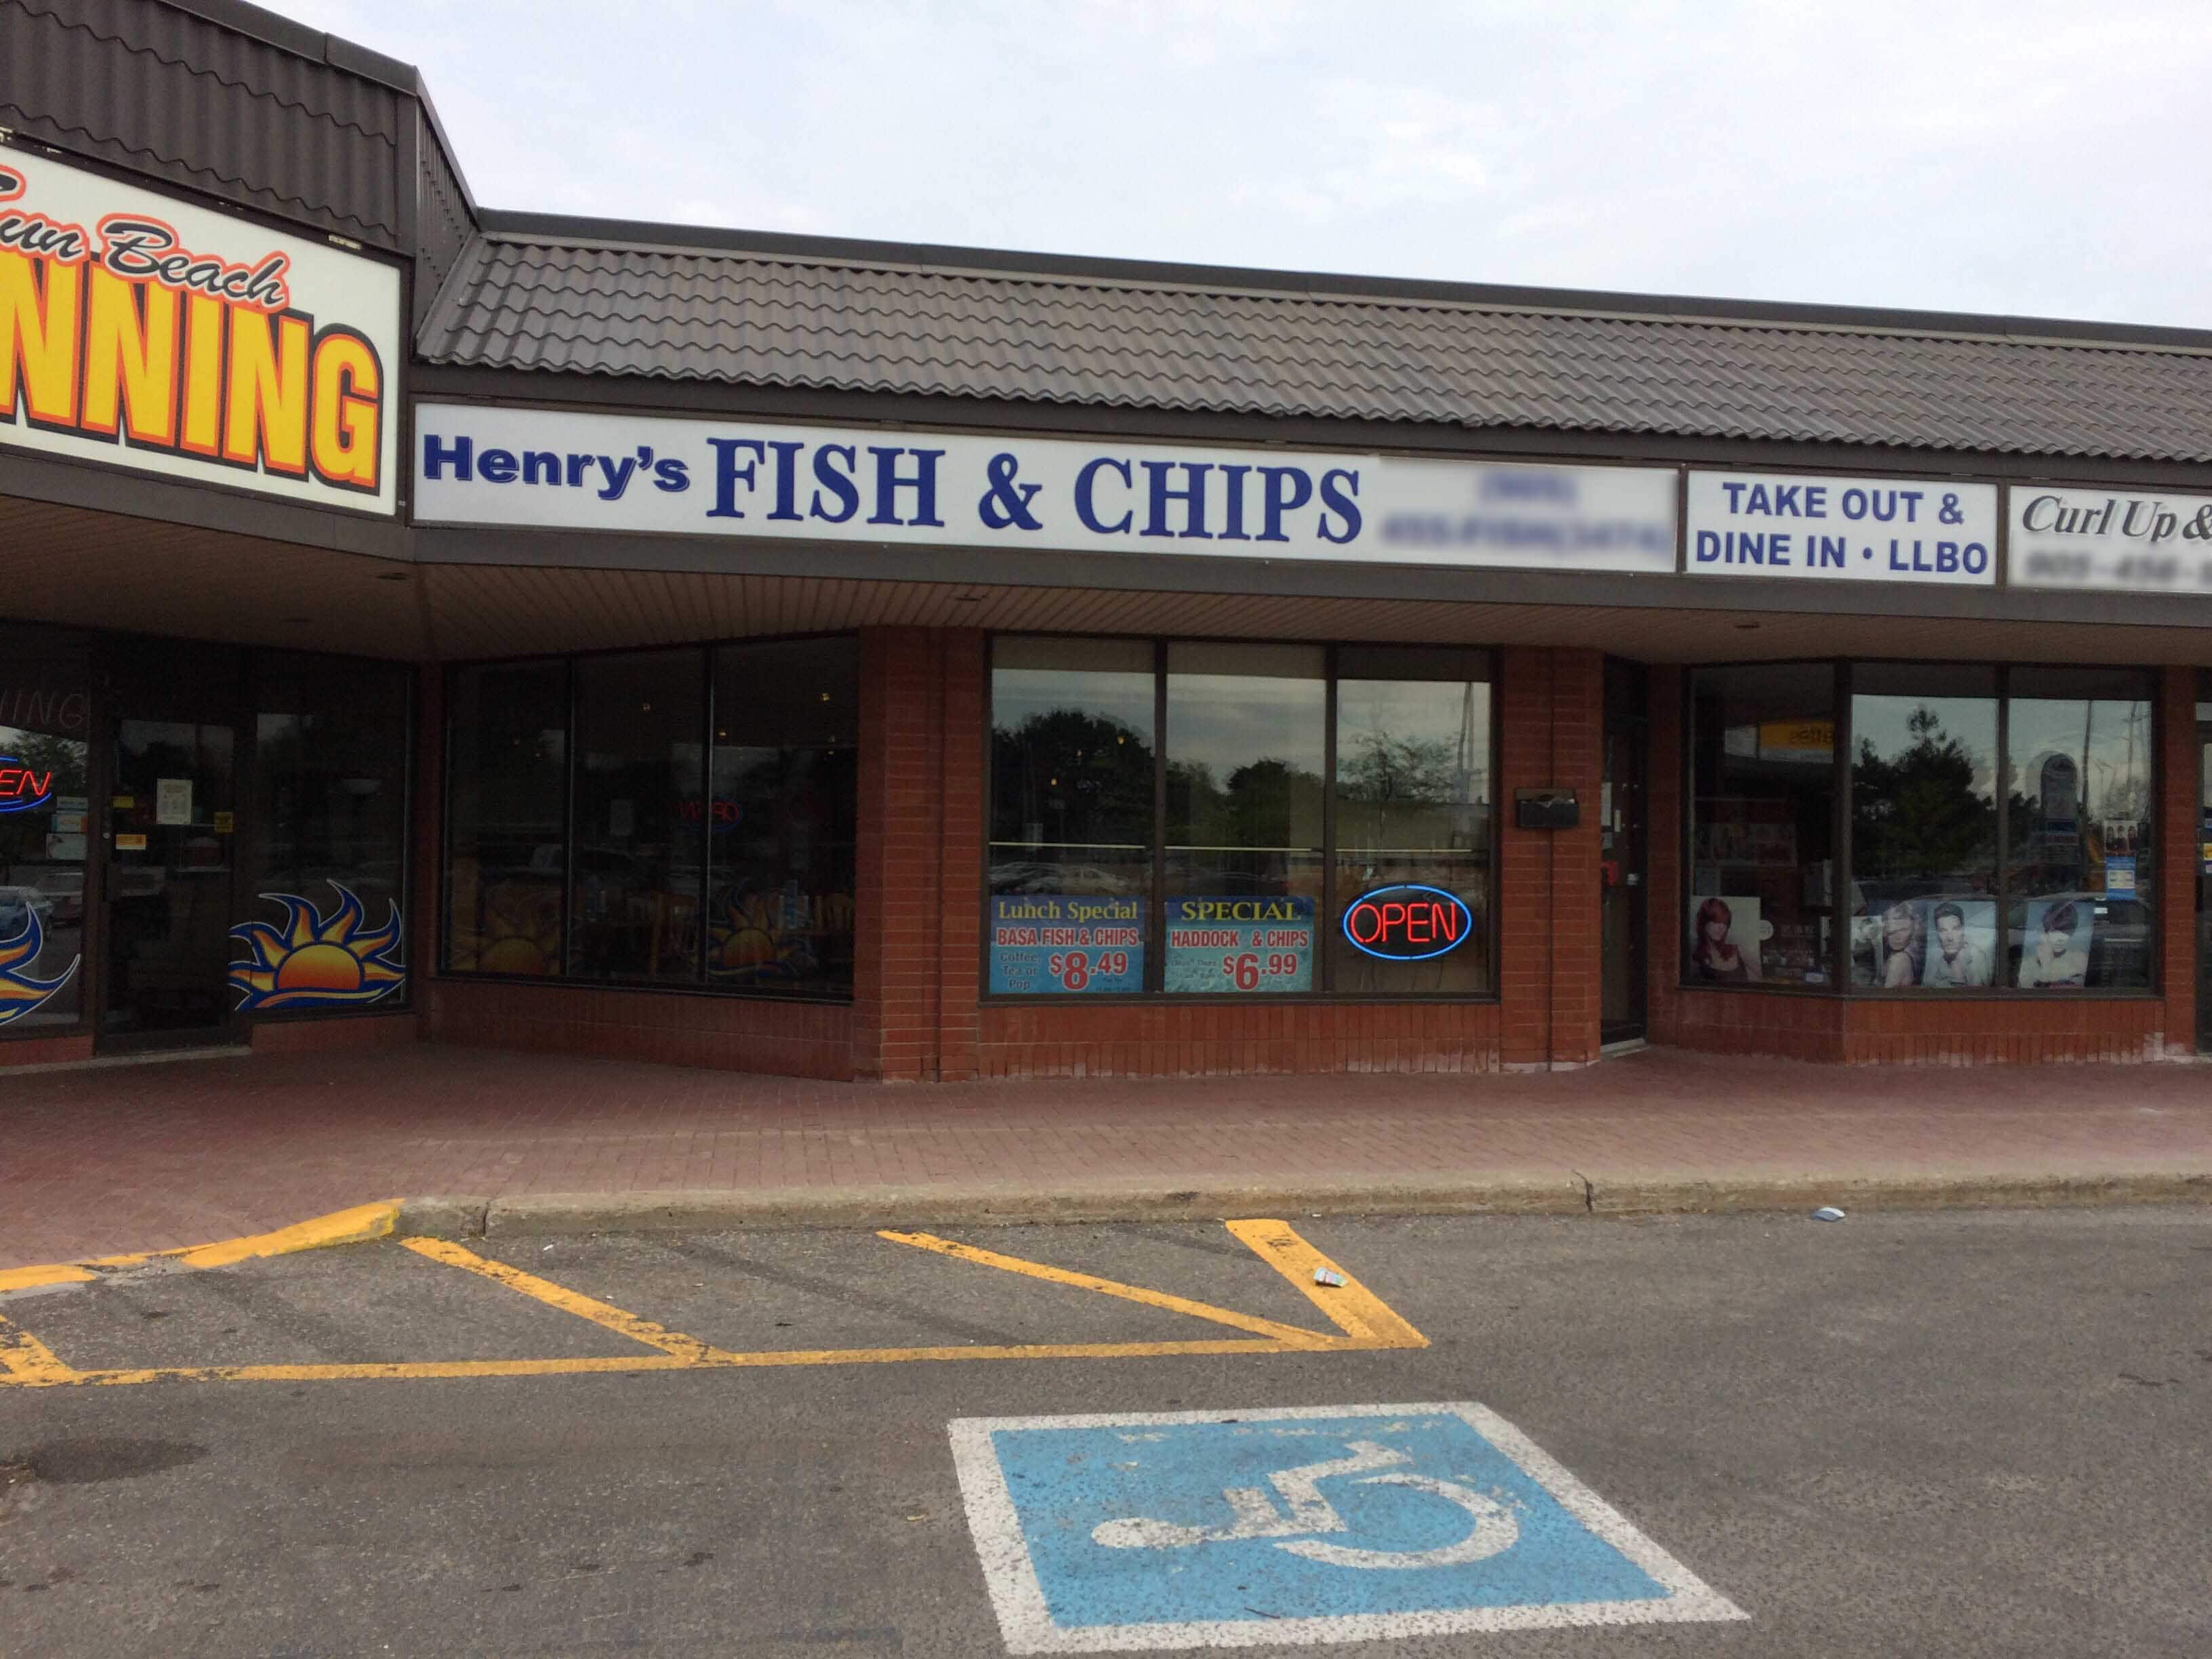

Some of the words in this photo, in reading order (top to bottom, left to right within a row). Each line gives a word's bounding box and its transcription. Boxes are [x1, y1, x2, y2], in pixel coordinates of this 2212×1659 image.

[102, 218, 286, 308] Beach
[423, 434, 689, 500] Henry's
[705, 437, 945, 527] FISH
[977, 452, 1042, 531] &
[1073, 456, 1363, 544] CHIPS
[1722, 481, 1827, 519] TAKE
[1841, 487, 1925, 523] OUT
[1938, 493, 1964, 525] &
[2022, 495, 2116, 535] Curl
[2122, 500, 2177, 542] Up
[2182, 504, 2212, 540] &
[1695, 530, 1791, 566] DINE
[1805, 535, 1847, 569] IN
[1887, 539, 1988, 576] LLBO
[0, 690, 83, 727] ING
[999, 901, 1061, 920] Lunch
[1067, 900, 1138, 922] Special
[1181, 901, 1300, 922] SPECIAL
[1349, 901, 1457, 944] OPEN
[998, 929, 1037, 945] BASA
[1042, 929, 1075, 945] FISH
[1079, 930, 1090, 945] &
[1094, 929, 1138, 945] CHIPS
[1171, 930, 1238, 947] HADDOCK
[1252, 932, 1262, 947] &
[1267, 931, 1308, 947] CHIPS
[1048, 951, 1128, 990] $8.49
[1223, 952, 1298, 990] $6.99
